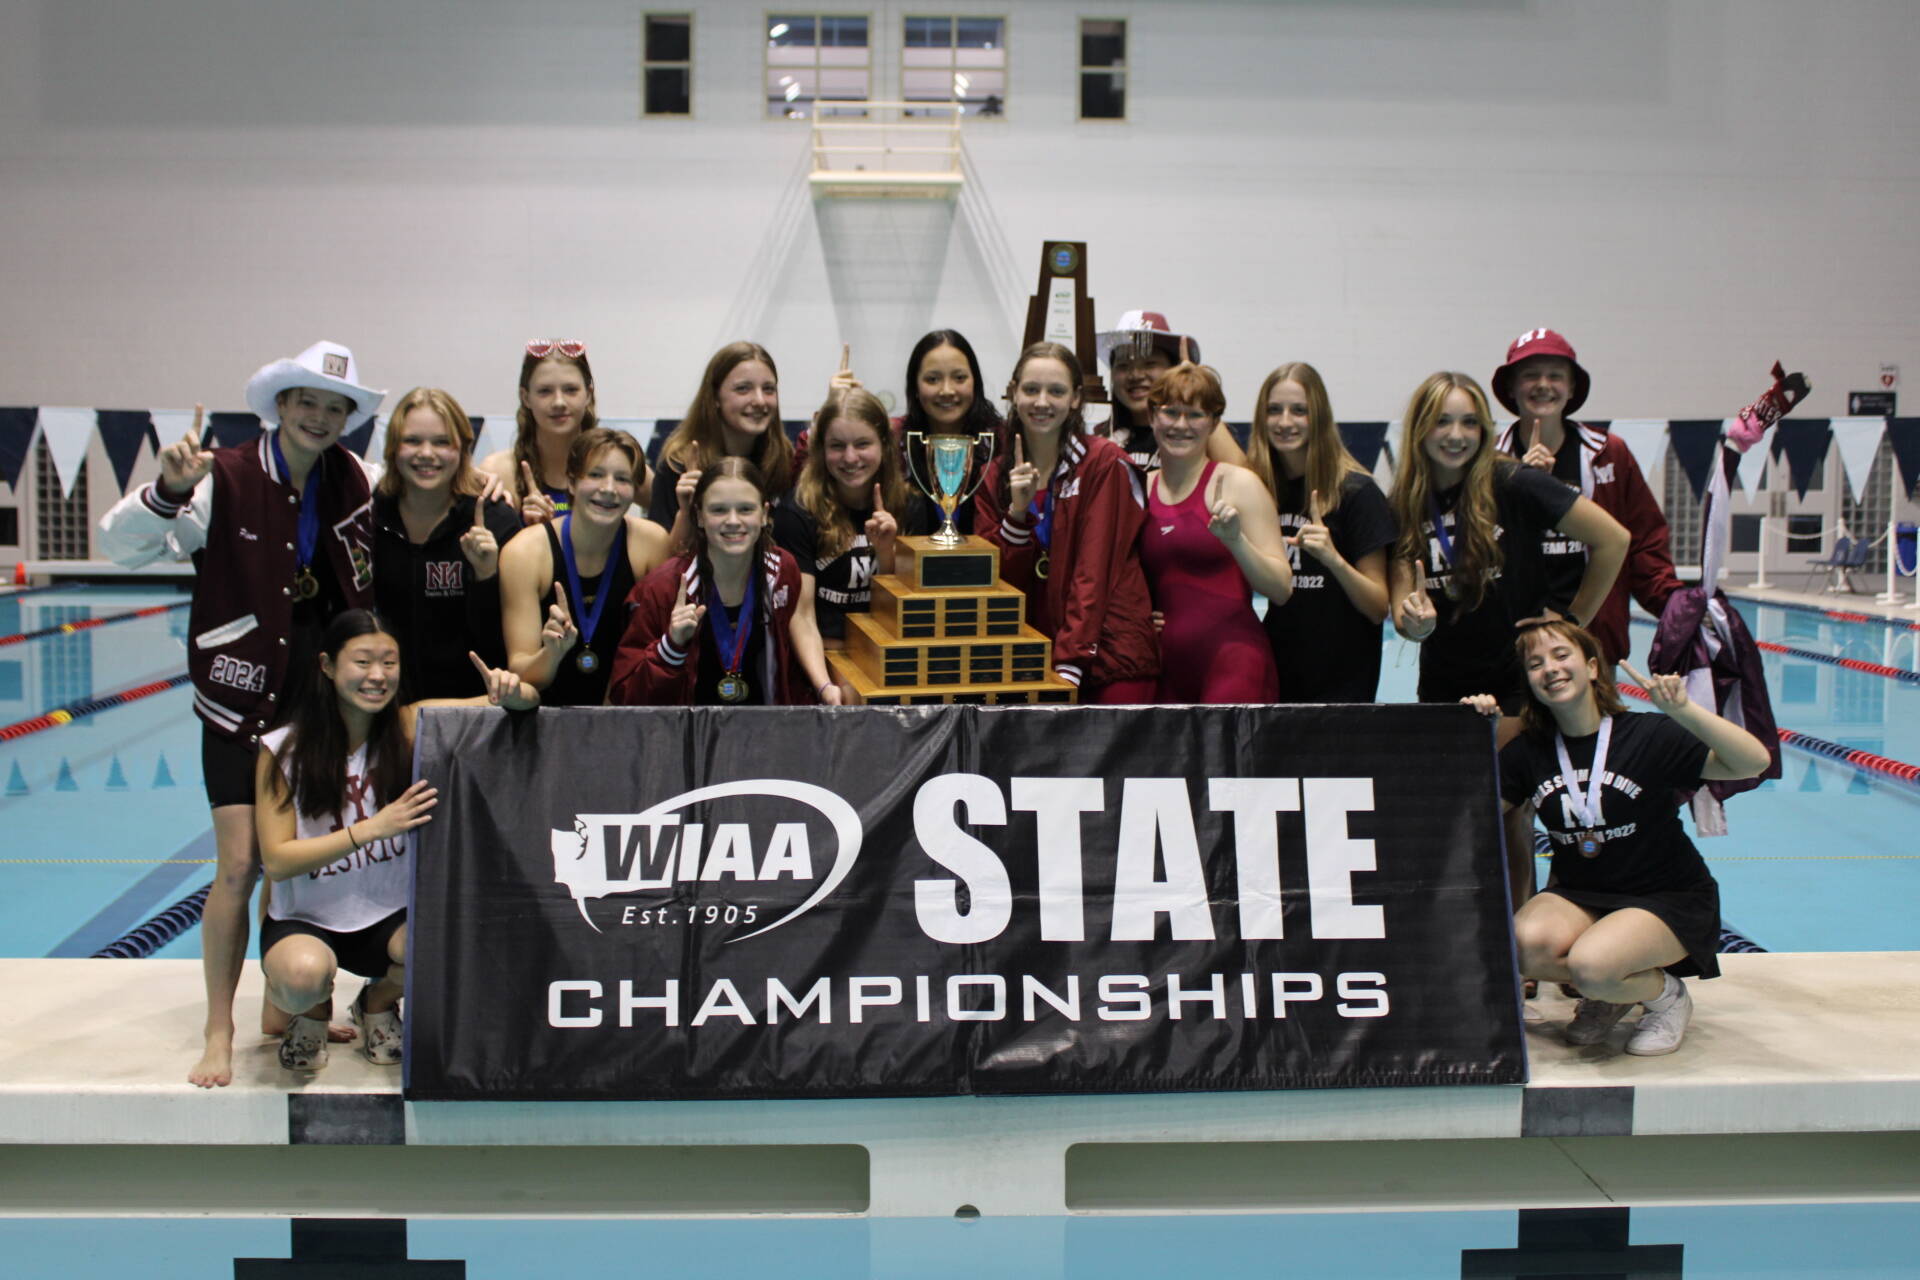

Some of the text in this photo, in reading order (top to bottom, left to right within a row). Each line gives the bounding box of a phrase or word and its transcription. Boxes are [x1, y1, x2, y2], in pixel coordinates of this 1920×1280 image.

[818, 586, 849, 604] STATE
[1298, 575, 1324, 588] 2022
[209, 654, 267, 692] 2024
[1612, 774, 1642, 800] DIVE
[1605, 823, 1636, 841] 2022
[602, 822, 813, 882] WIAA
[912, 773, 1386, 944] STATE
[547, 972, 1390, 1028] CHAMPIONSHIPS
